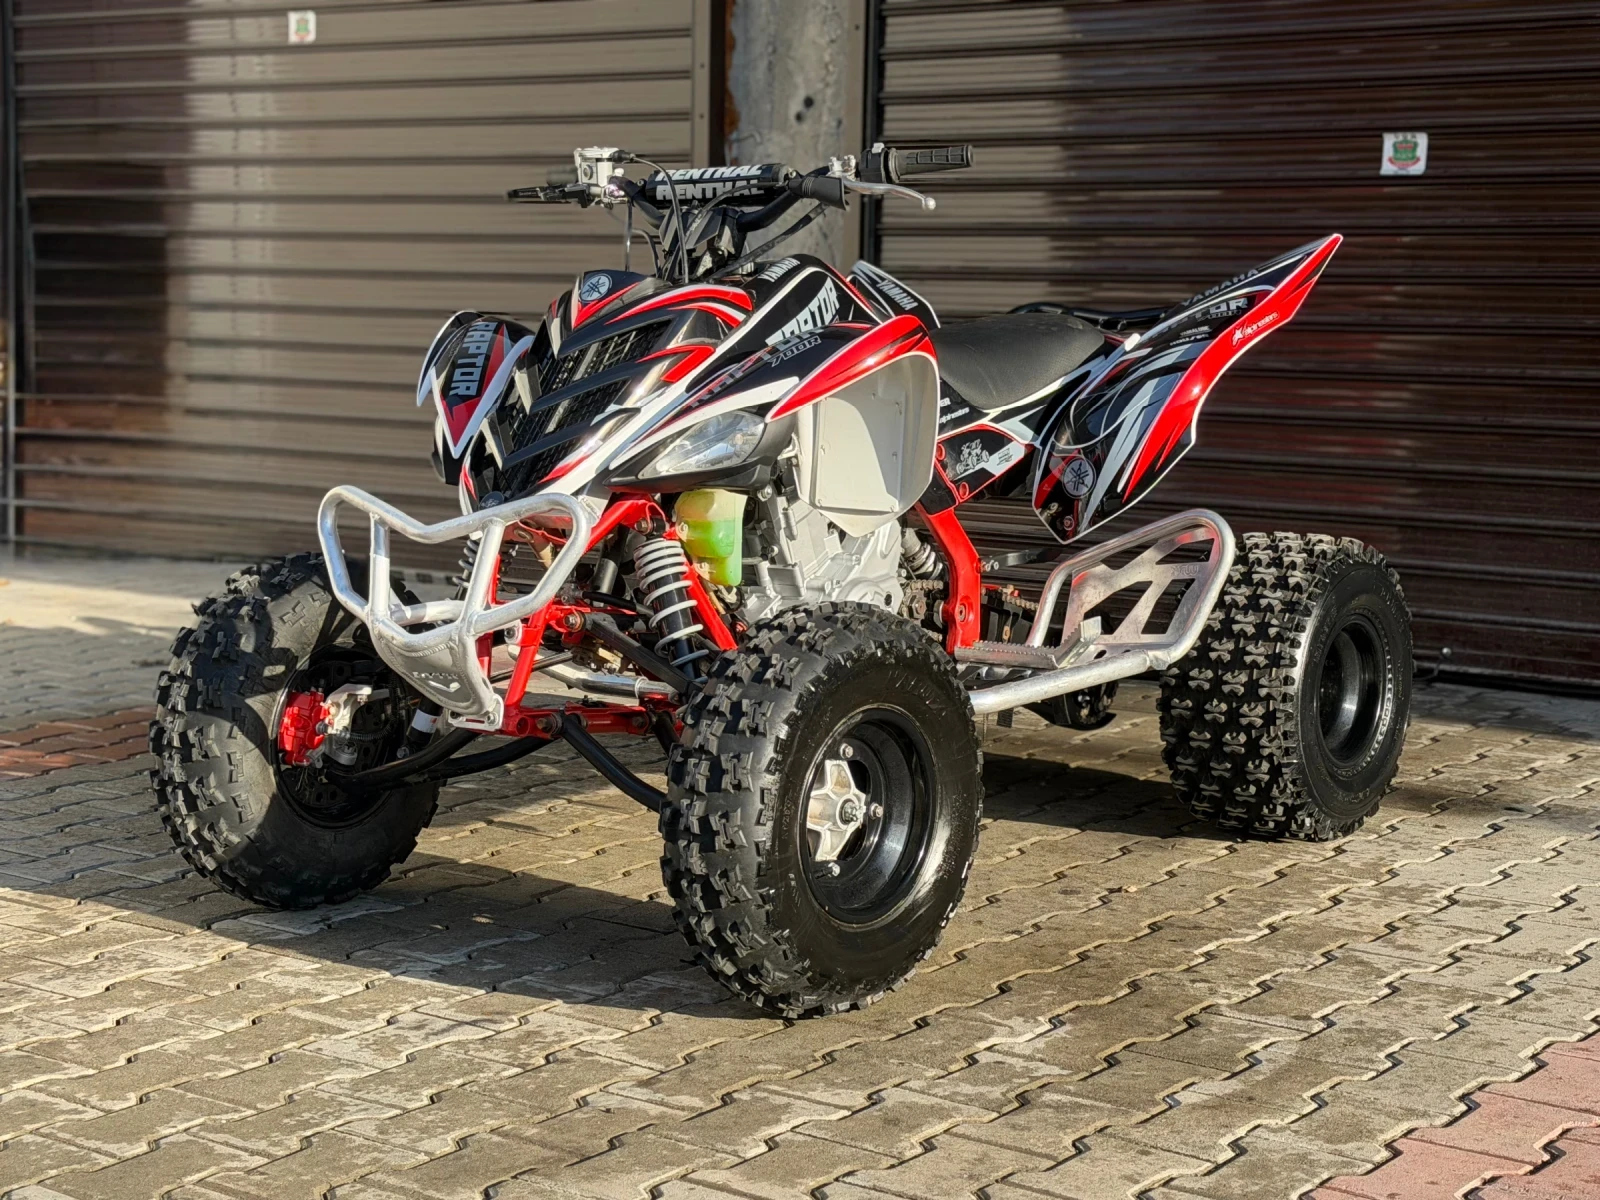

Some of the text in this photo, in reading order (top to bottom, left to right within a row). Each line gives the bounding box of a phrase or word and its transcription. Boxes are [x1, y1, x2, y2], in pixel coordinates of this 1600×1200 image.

[655, 164, 762, 181] RENTHAL
[655, 180, 765, 201] RENTHAL
[757, 257, 801, 283] YAMAHA
[876, 279, 919, 311] YAMAHA
[1181, 268, 1259, 306] YAMAHA
[448, 321, 499, 396] RAPTOR
[767, 335, 823, 368] 700R
